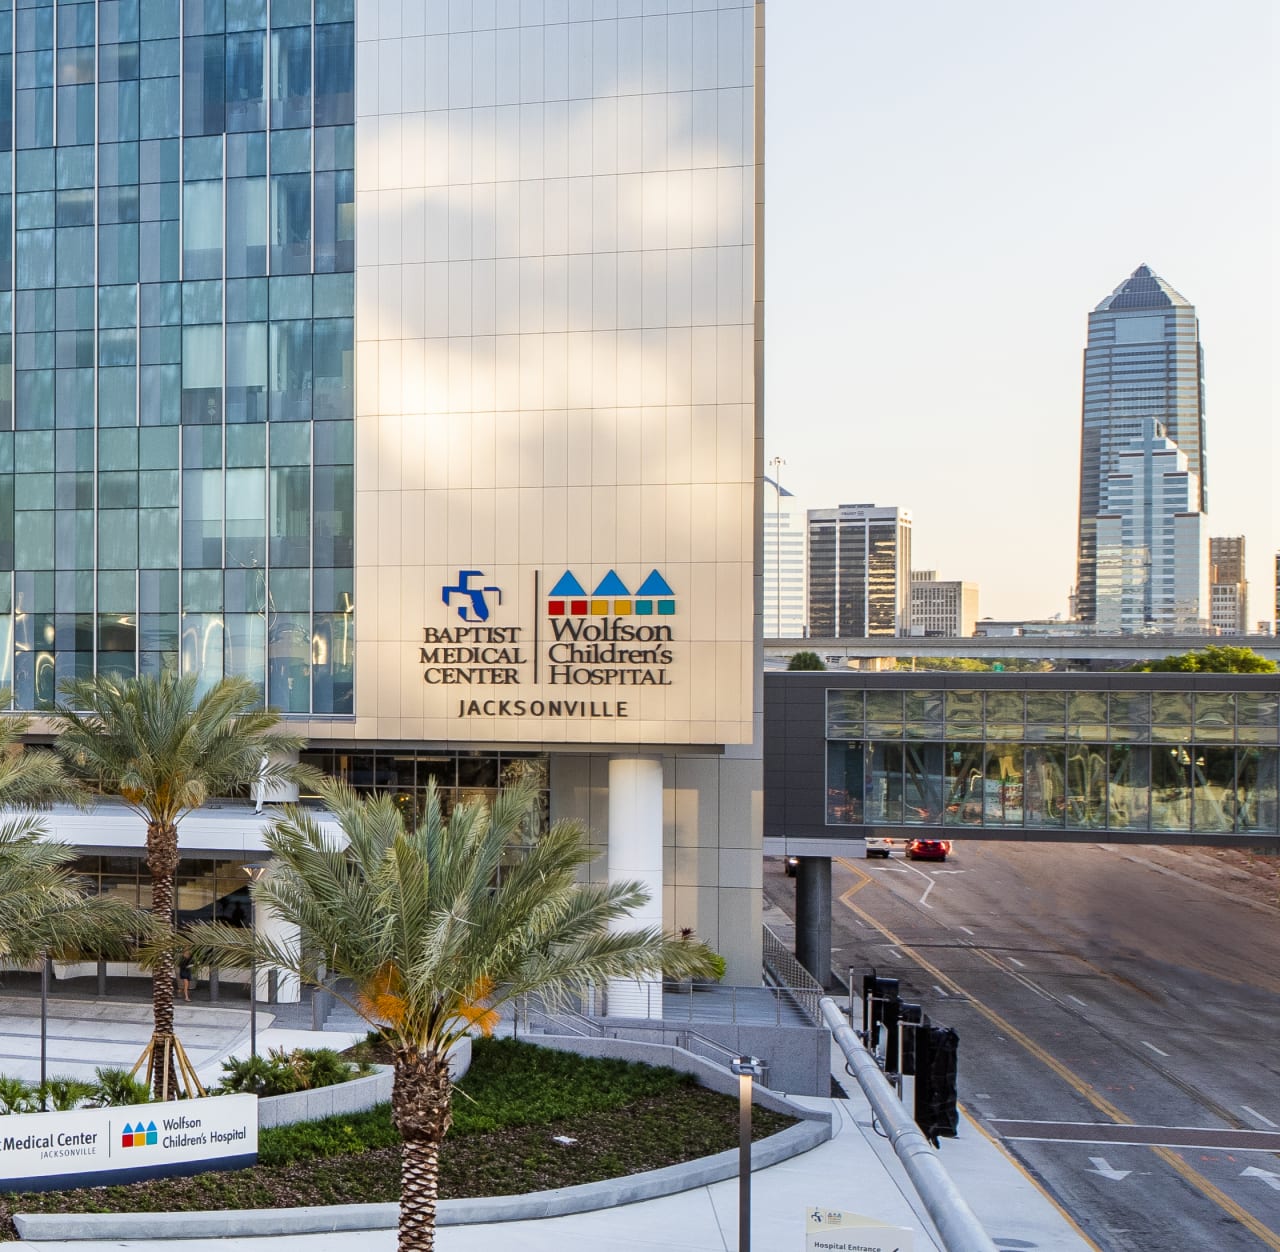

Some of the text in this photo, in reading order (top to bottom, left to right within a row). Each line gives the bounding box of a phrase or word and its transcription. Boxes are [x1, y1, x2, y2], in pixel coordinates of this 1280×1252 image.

[423, 627, 522, 643] BAPTIST
[548, 617, 674, 642] Wolfson
[419, 647, 527, 664] MEDICAL
[548, 643, 673, 664] Children's
[424, 667, 521, 684] CENTER
[548, 664, 672, 685] HOSPITAL
[458, 700, 628, 718] JACKSONVILLE
[162, 1116, 201, 1131] Wolfson
[3, 1133, 54, 1151] Medical
[57, 1132, 98, 1147] Center
[162, 1125, 246, 1148] Children's Hospital
[40, 1147, 97, 1160] JACKSONVILLE
[814, 1242, 881, 1252] Hospital Entrance
